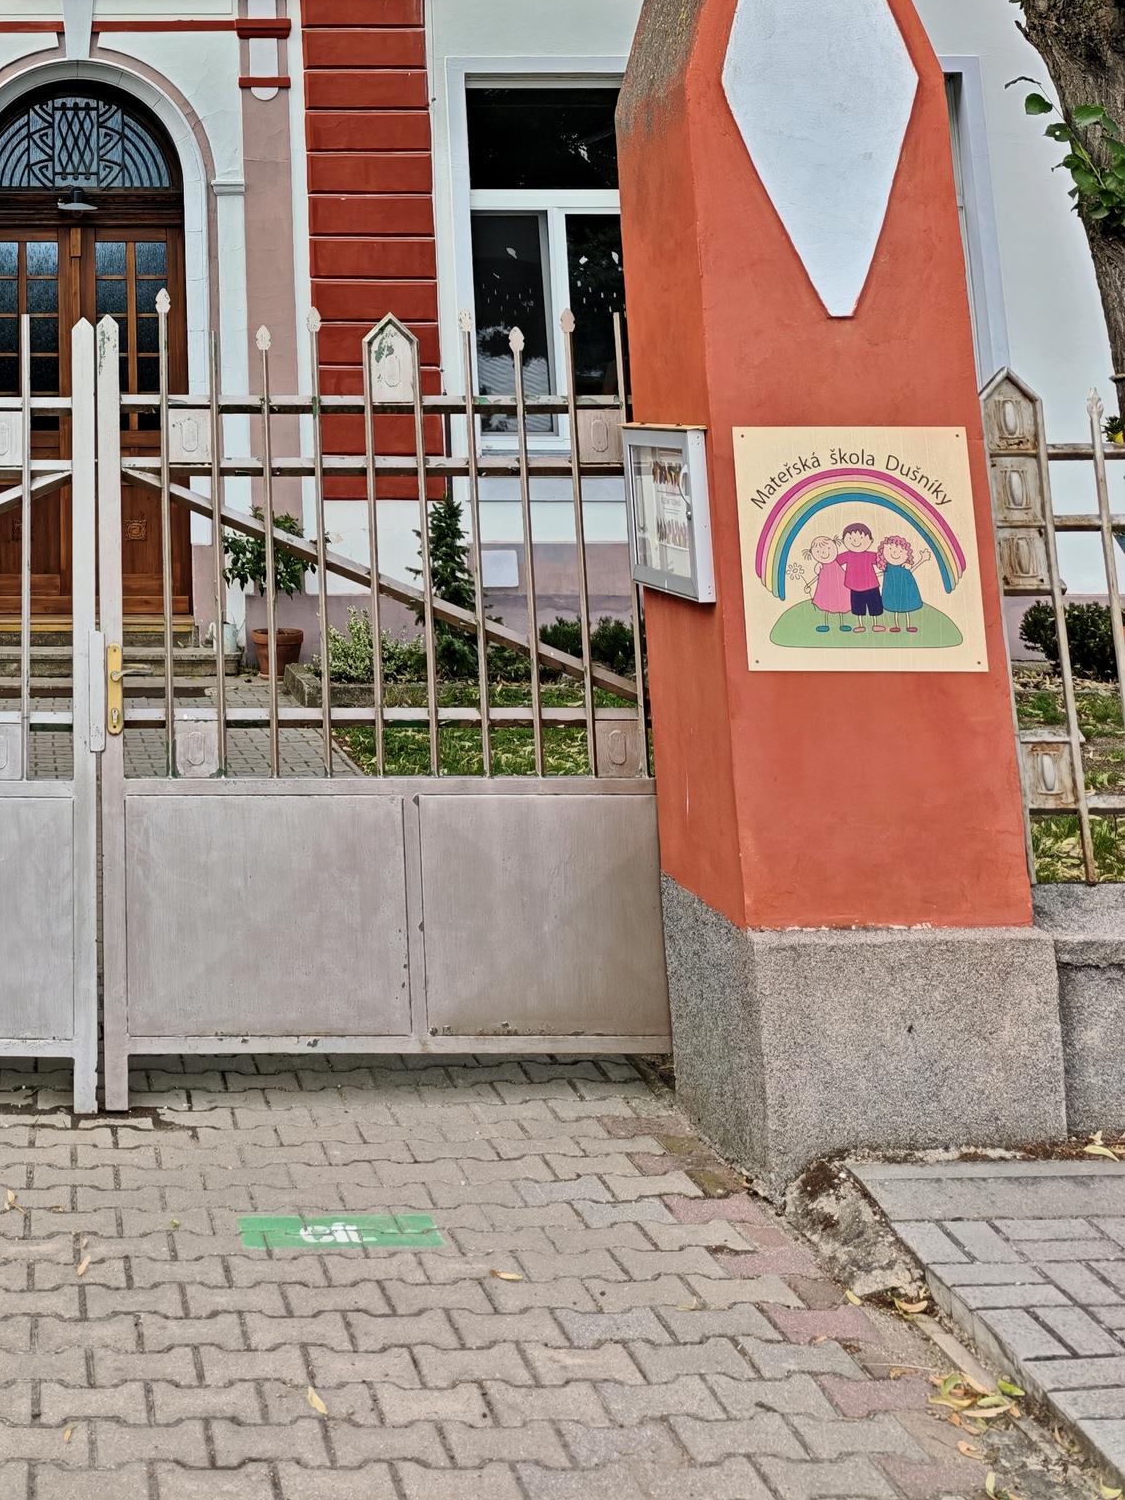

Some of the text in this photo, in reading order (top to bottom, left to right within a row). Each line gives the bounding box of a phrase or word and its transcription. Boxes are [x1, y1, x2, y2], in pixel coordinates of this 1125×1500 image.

[750, 448, 952, 510] Mateřská škola Dušníky
